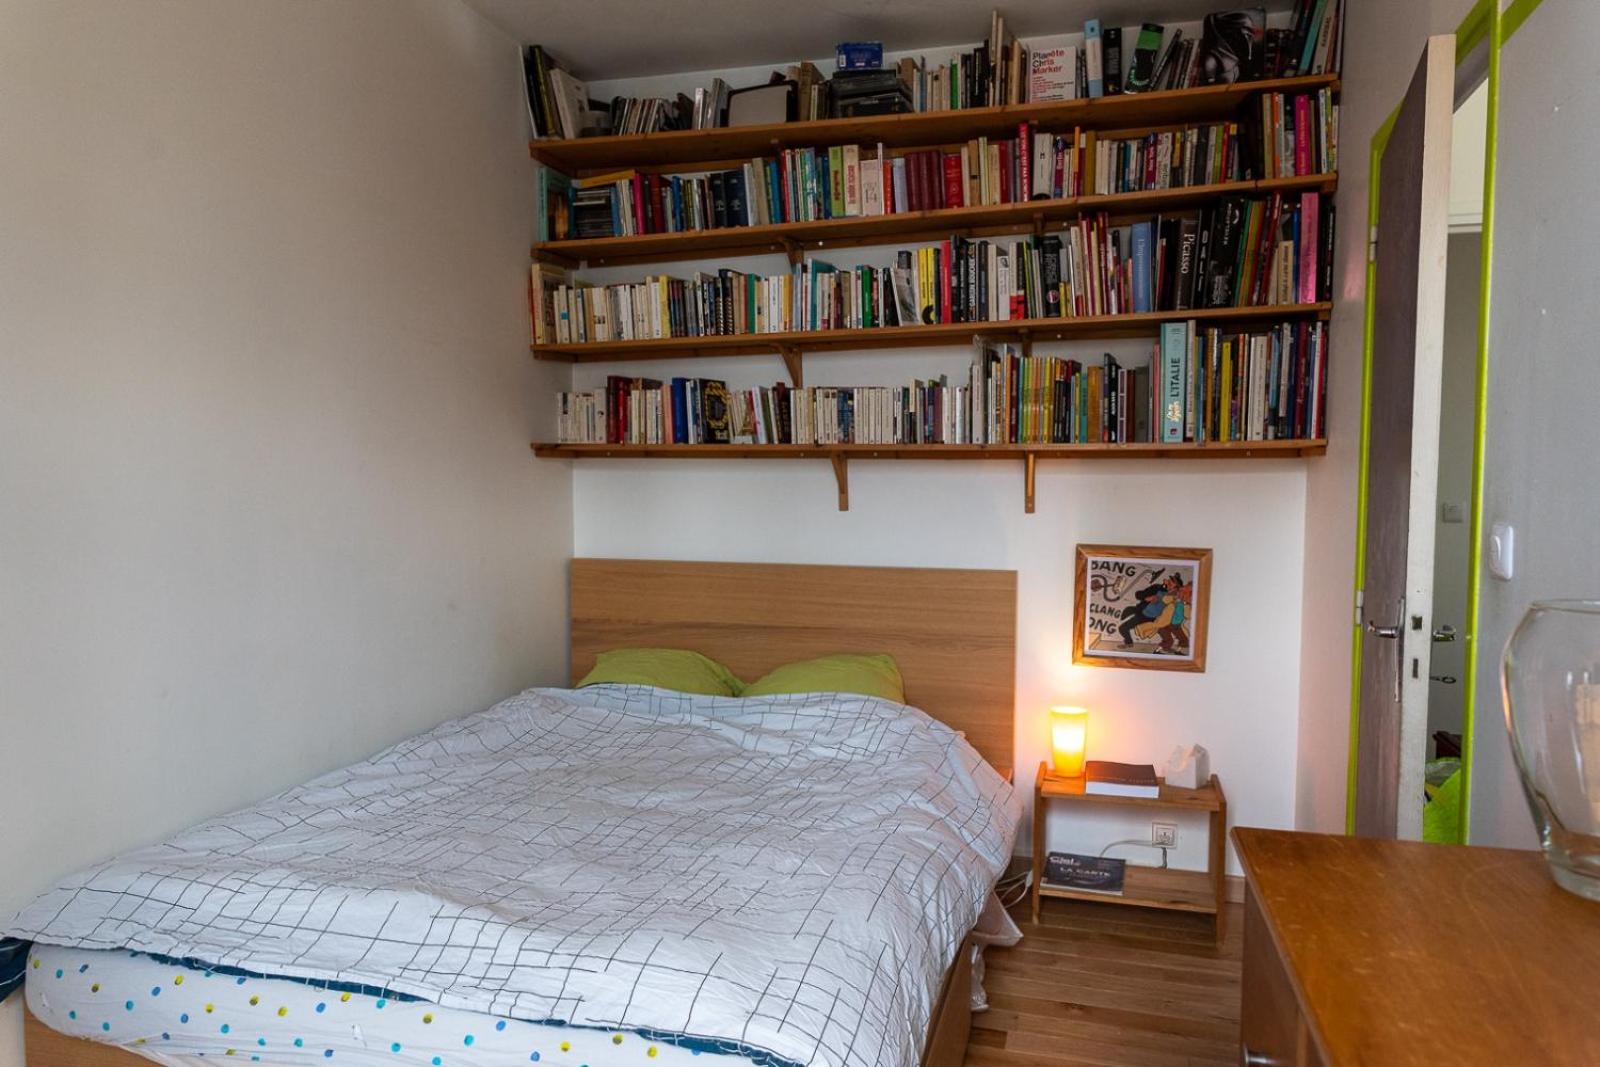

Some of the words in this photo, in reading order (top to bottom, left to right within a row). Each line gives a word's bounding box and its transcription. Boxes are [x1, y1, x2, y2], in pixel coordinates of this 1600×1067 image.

[1032, 60, 1055, 68] Chris
[1032, 65, 1063, 74] Marker
[1181, 233, 1195, 274] Picasso
[1170, 357, 1181, 398] L'ITALIE
